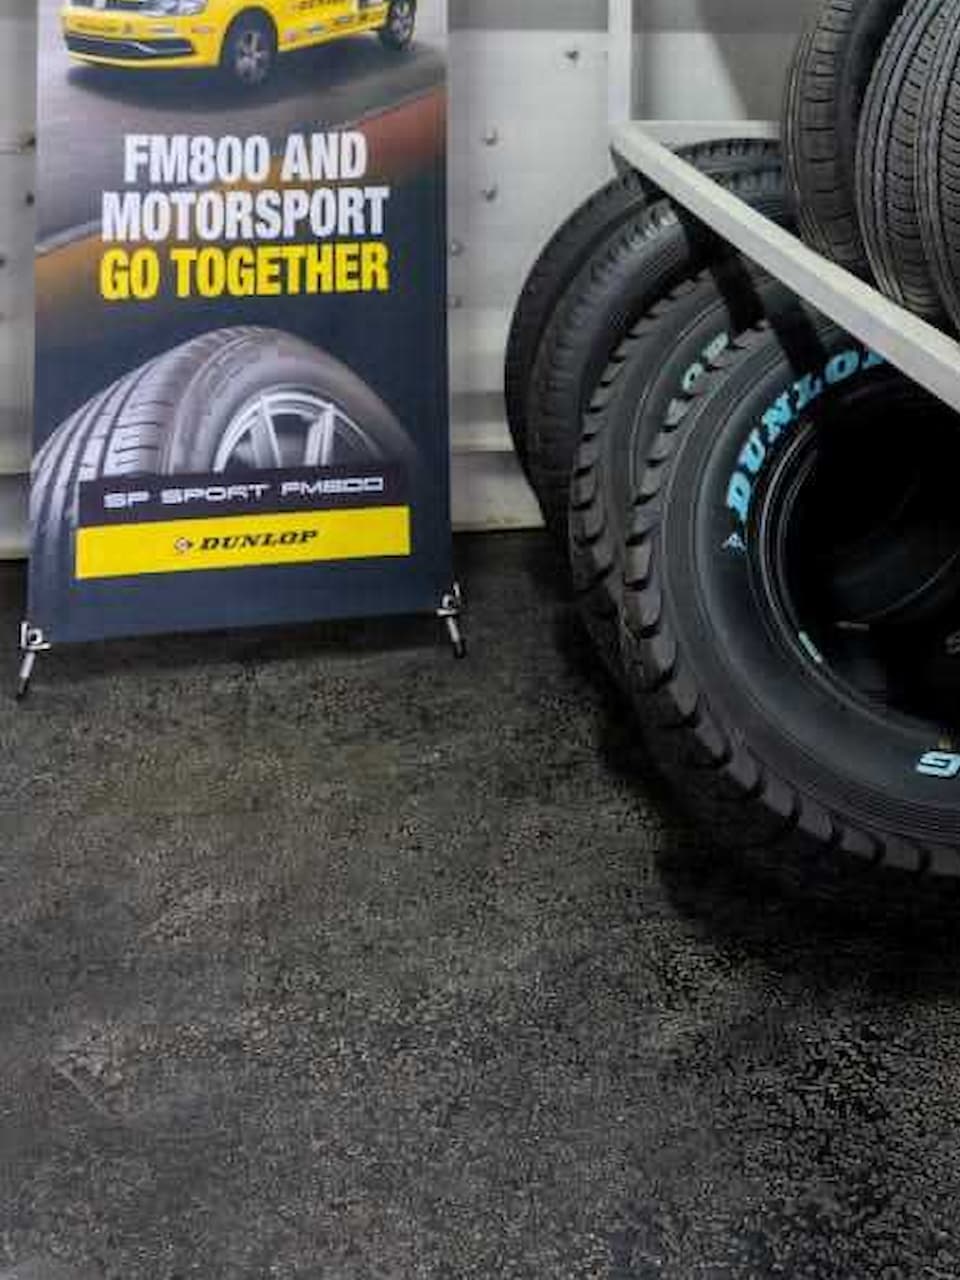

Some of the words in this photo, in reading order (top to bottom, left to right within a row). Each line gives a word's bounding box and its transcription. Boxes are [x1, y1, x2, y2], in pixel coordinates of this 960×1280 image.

[124, 133, 270, 184] FM800
[281, 131, 368, 181] AND
[101, 186, 390, 242] MOTORSPORT
[100, 246, 160, 300] GO
[169, 241, 390, 299] TOGETHER
[104, 490, 149, 509] SP
[161, 483, 270, 505] SPORT
[280, 476, 384, 495] FM800
[198, 530, 320, 552] DUNLOP
